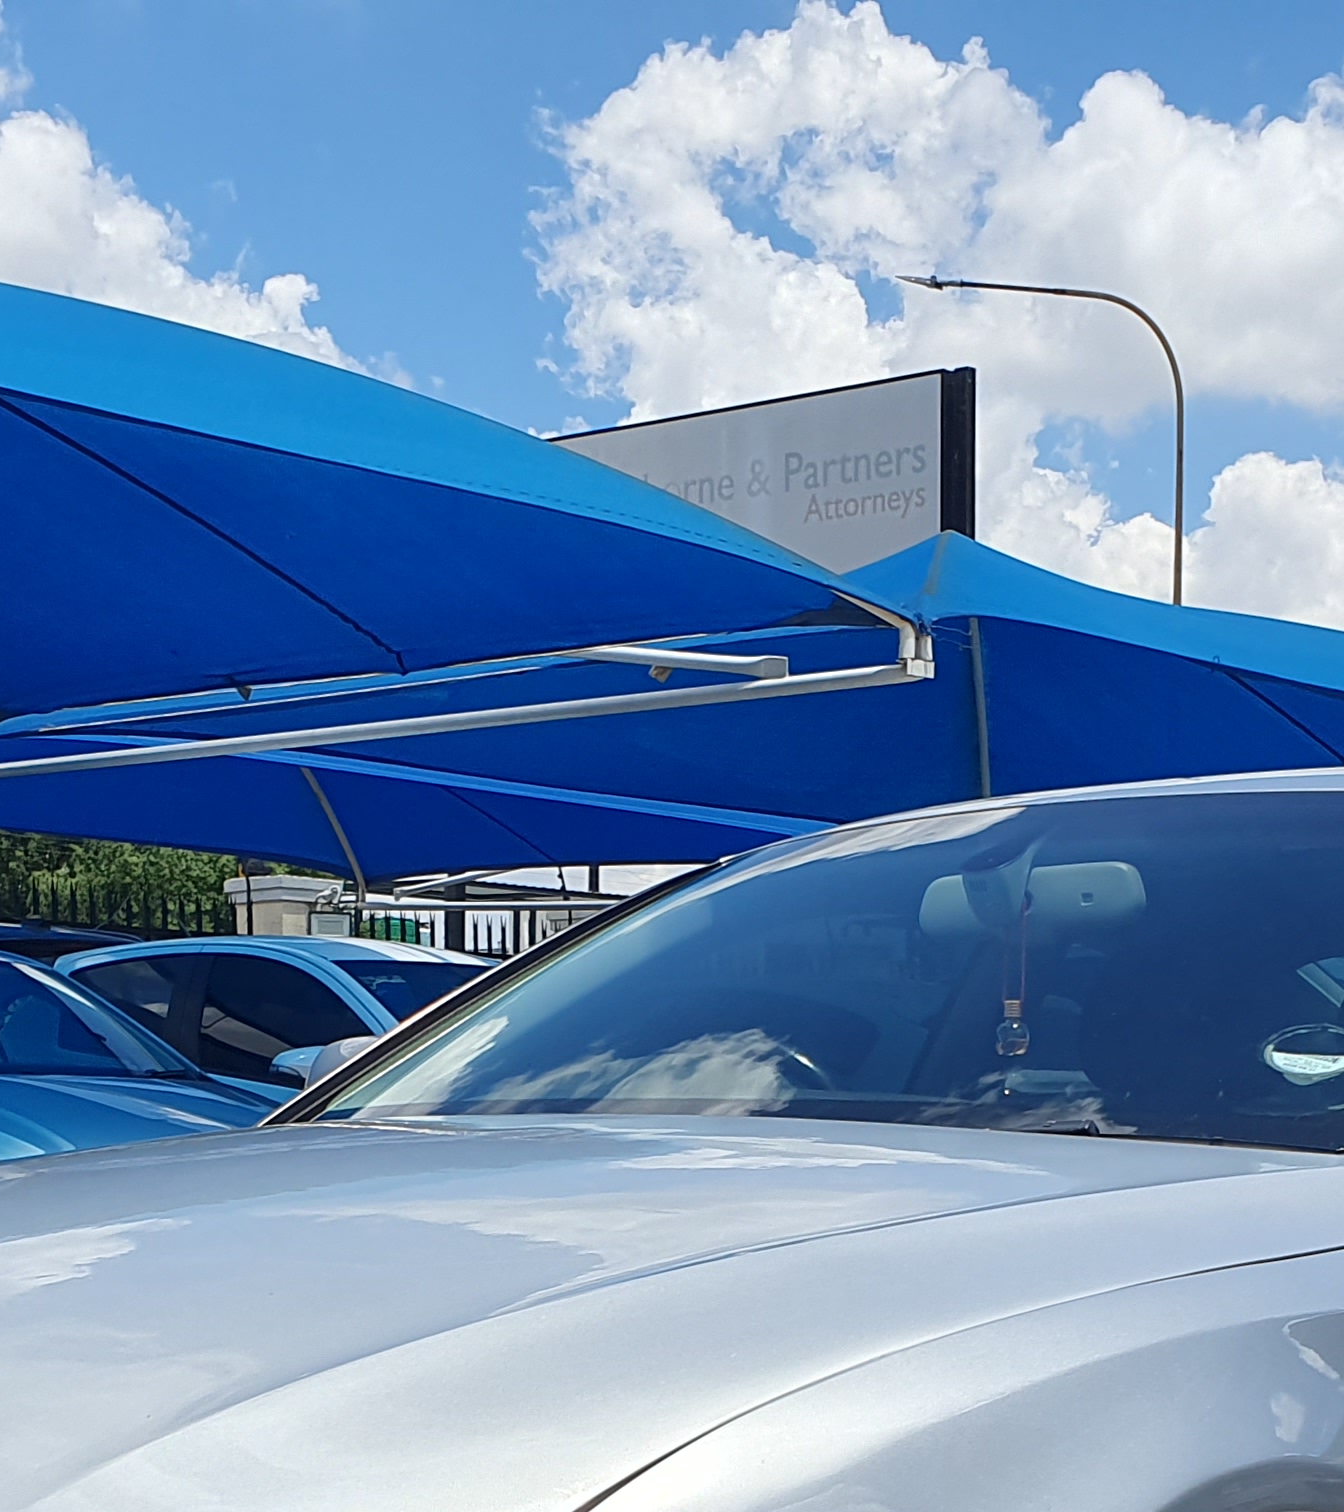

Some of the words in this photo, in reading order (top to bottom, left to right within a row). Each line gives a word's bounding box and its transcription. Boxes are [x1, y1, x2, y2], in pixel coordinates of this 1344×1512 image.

[644, 473, 735, 504] orne
[747, 458, 771, 498] &
[784, 443, 927, 493] Partners
[803, 486, 926, 524] Attorneys
